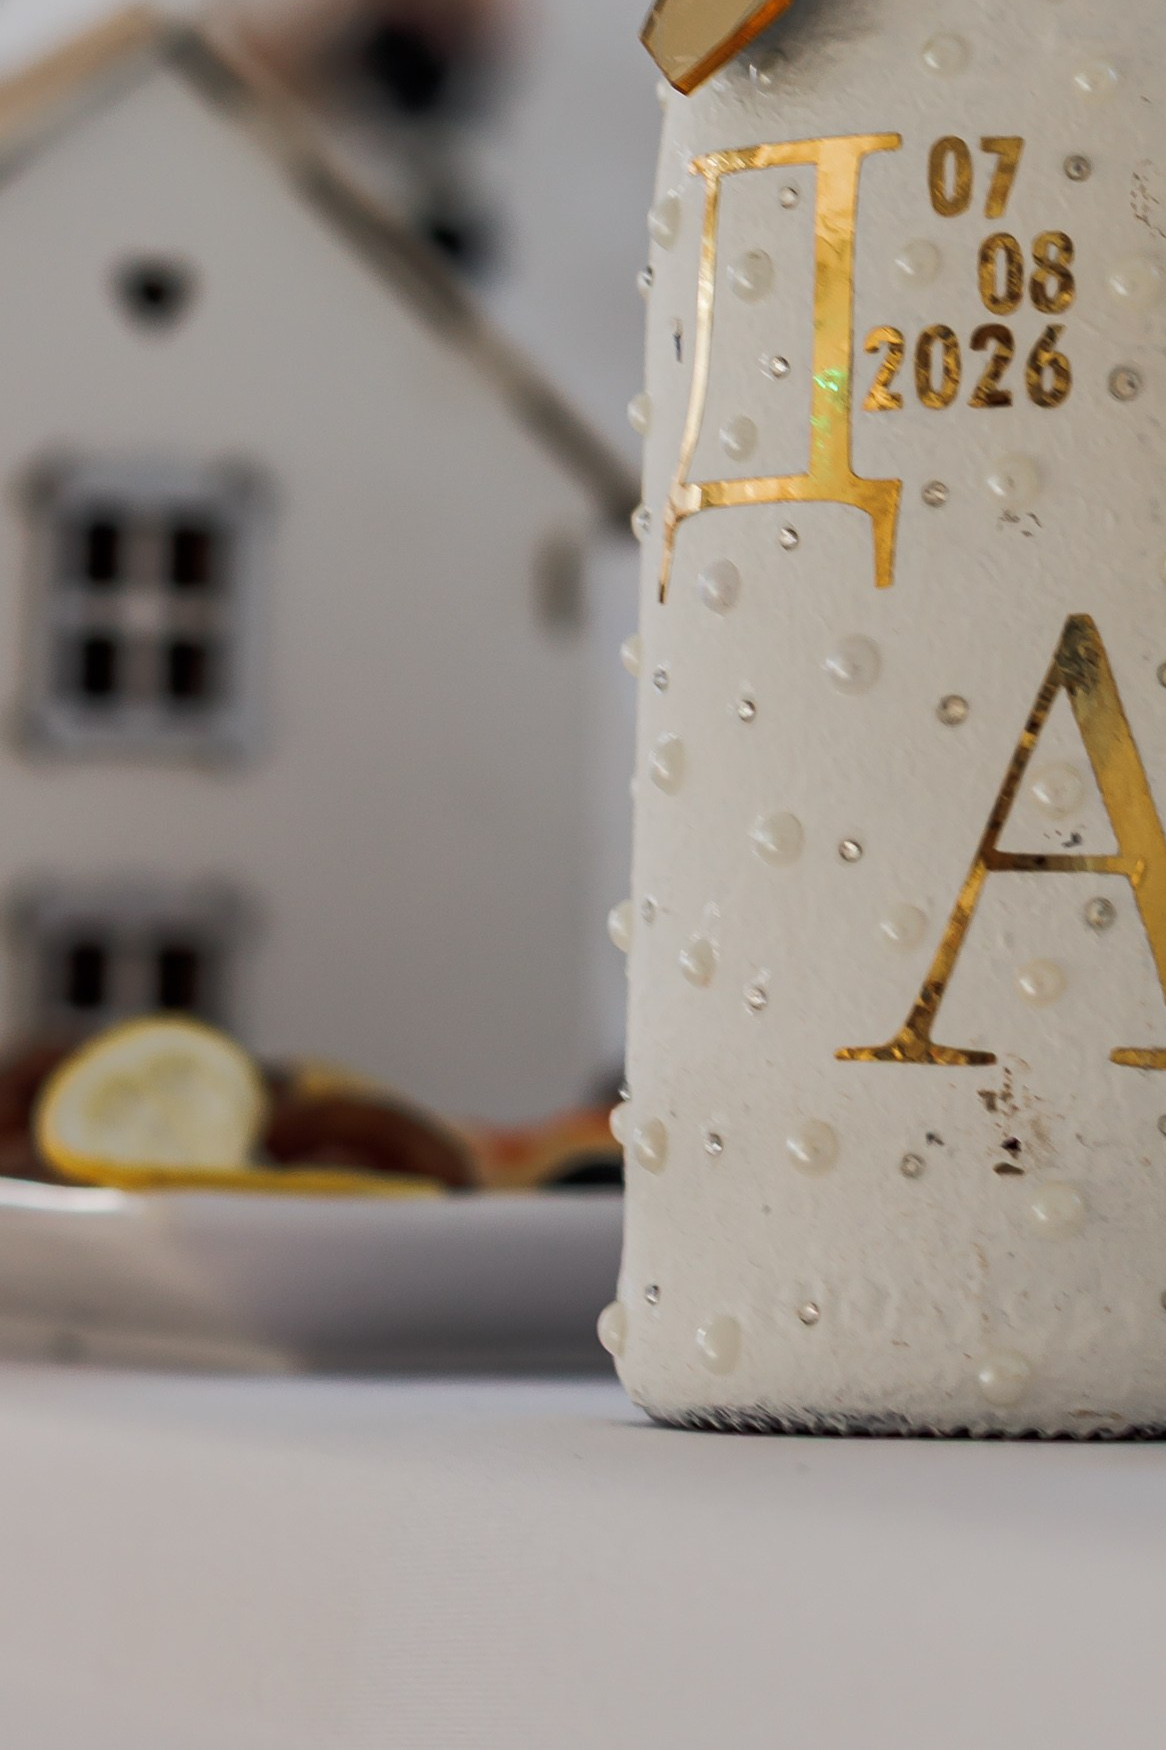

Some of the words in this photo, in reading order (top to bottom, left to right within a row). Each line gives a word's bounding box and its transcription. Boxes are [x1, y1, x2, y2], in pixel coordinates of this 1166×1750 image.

[927, 135, 1025, 218] 07
[977, 231, 1077, 315] 08
[861, 323, 1073, 412] 2026
